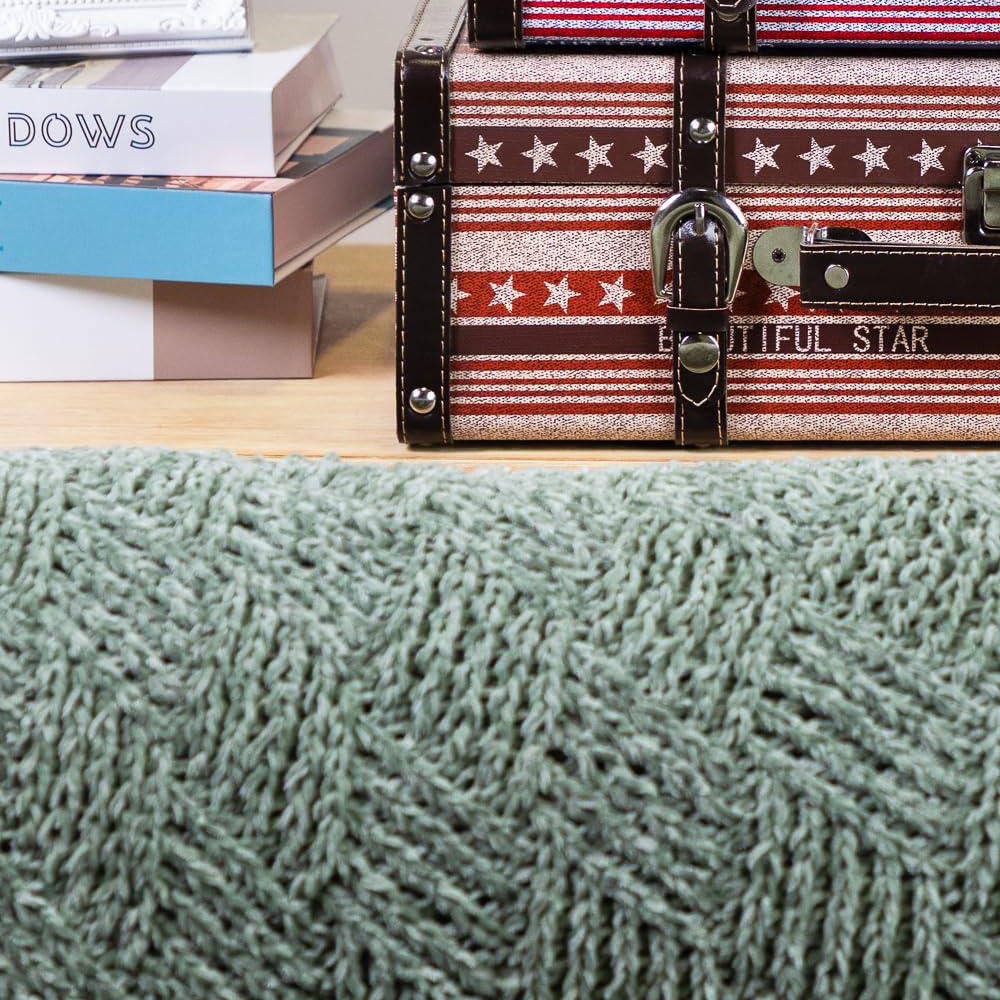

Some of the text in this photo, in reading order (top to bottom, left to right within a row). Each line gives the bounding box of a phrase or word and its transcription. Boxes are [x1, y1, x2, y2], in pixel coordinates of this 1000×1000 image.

[7, 112, 156, 150] DOWS
[658, 324, 930, 353] BTIFUL STAR
